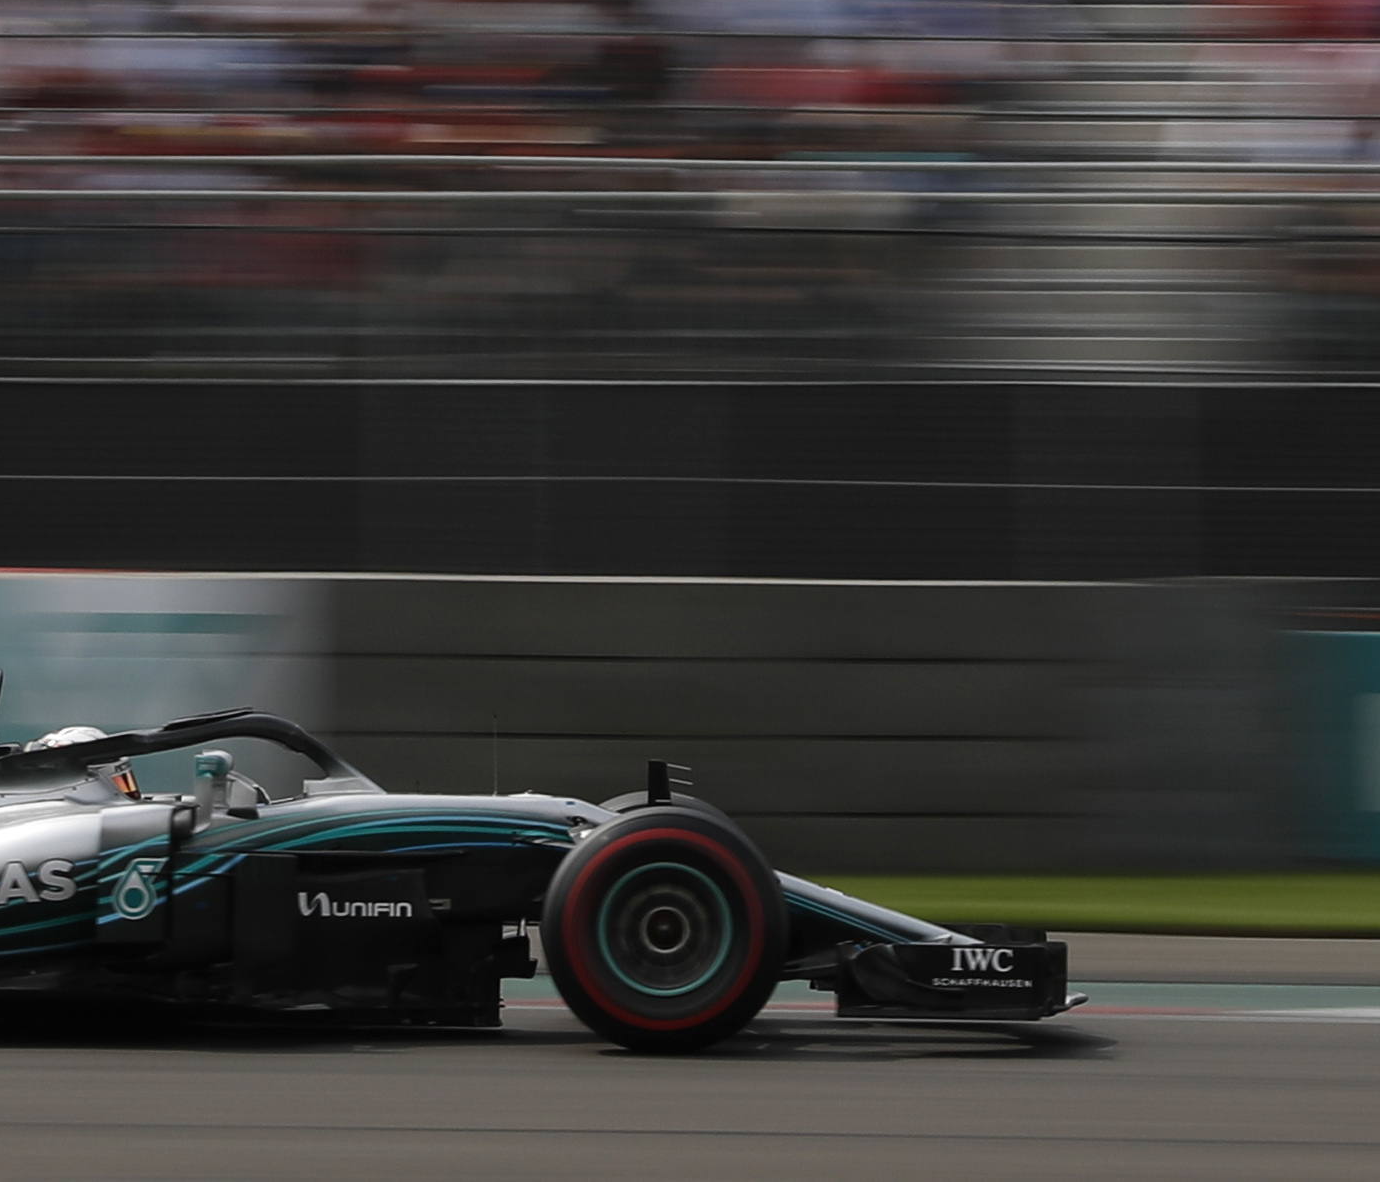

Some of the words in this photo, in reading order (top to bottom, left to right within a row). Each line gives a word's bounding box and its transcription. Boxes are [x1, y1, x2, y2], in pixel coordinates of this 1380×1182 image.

[332, 901, 413, 917] UNIFIN
[950, 948, 1014, 972] IWC
[932, 978, 1033, 987] SCHAFFHAUSEN
